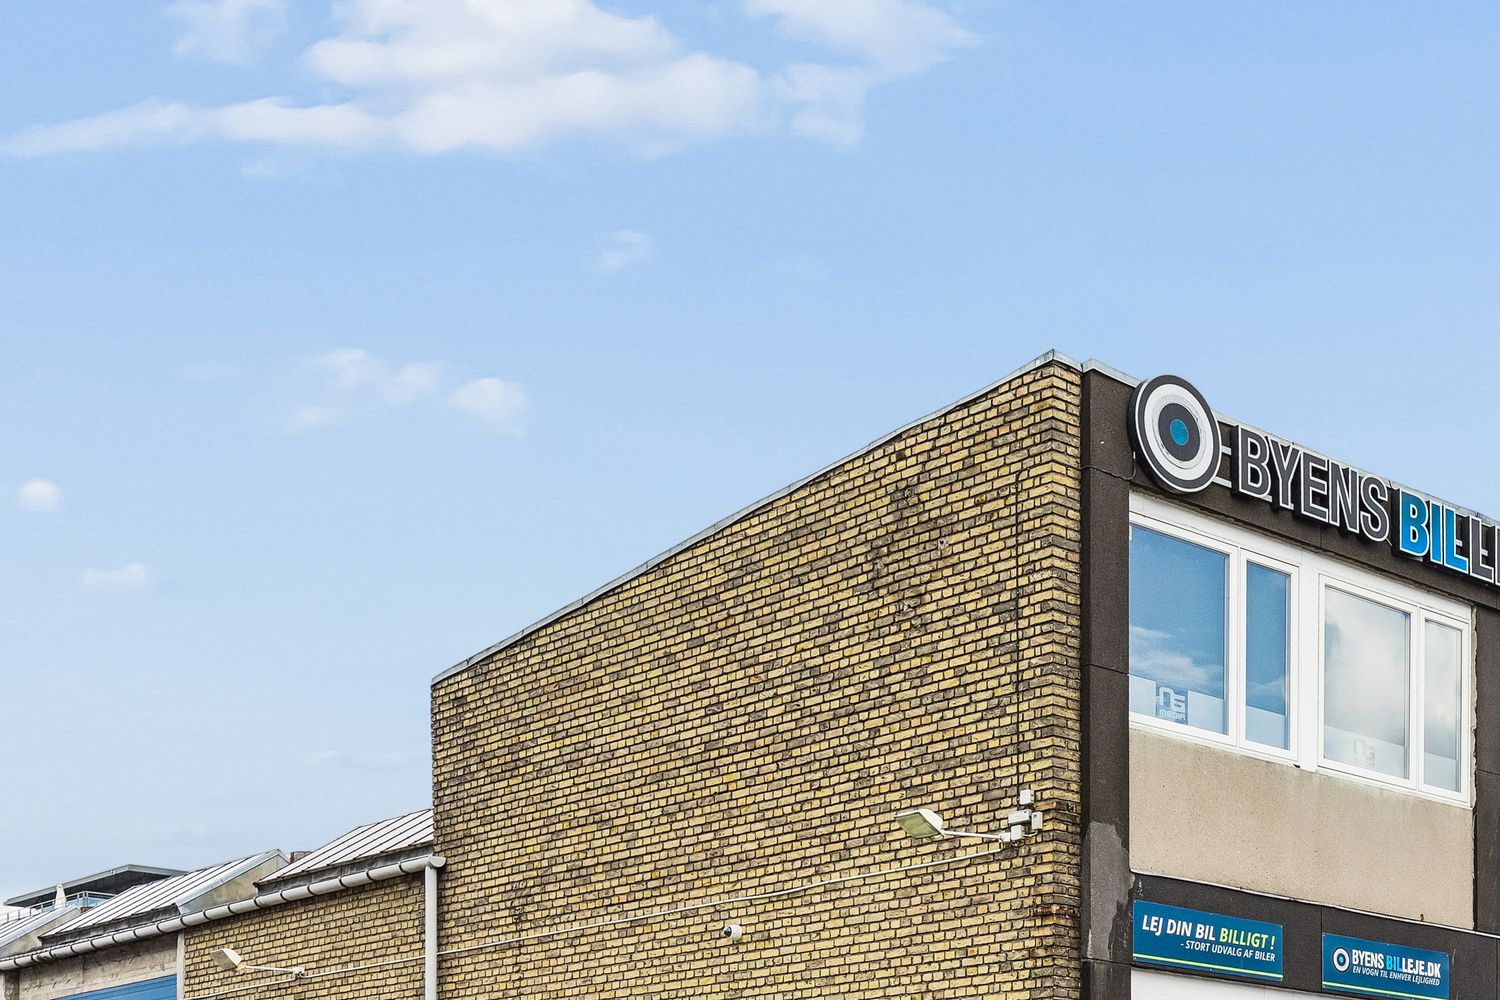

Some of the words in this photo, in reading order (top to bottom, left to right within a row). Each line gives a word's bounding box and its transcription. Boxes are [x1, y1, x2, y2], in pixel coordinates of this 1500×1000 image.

[1236, 424, 1389, 542] BYENS
[1142, 914, 1163, 936] LEJ
[1166, 919, 1192, 937] DIN
[1195, 923, 1216, 941] BIL
[1219, 927, 1268, 948] BILLIGT
[1185, 940, 1210, 952] STORT
[1211, 943, 1242, 957] UDVALG
[1243, 949, 1254, 958] AF
[1254, 950, 1276, 962] BILER
[1351, 949, 1384, 969] BYENS
[1386, 954, 1441, 978] BILLEJE.DK
[1352, 965, 1360, 974] EN
[1362, 967, 1379, 977] VOGN
[1380, 970, 1389, 978] TIL
[1389, 971, 1412, 981] ENHVER
[1412, 974, 1440, 986] LEJLIGHED
